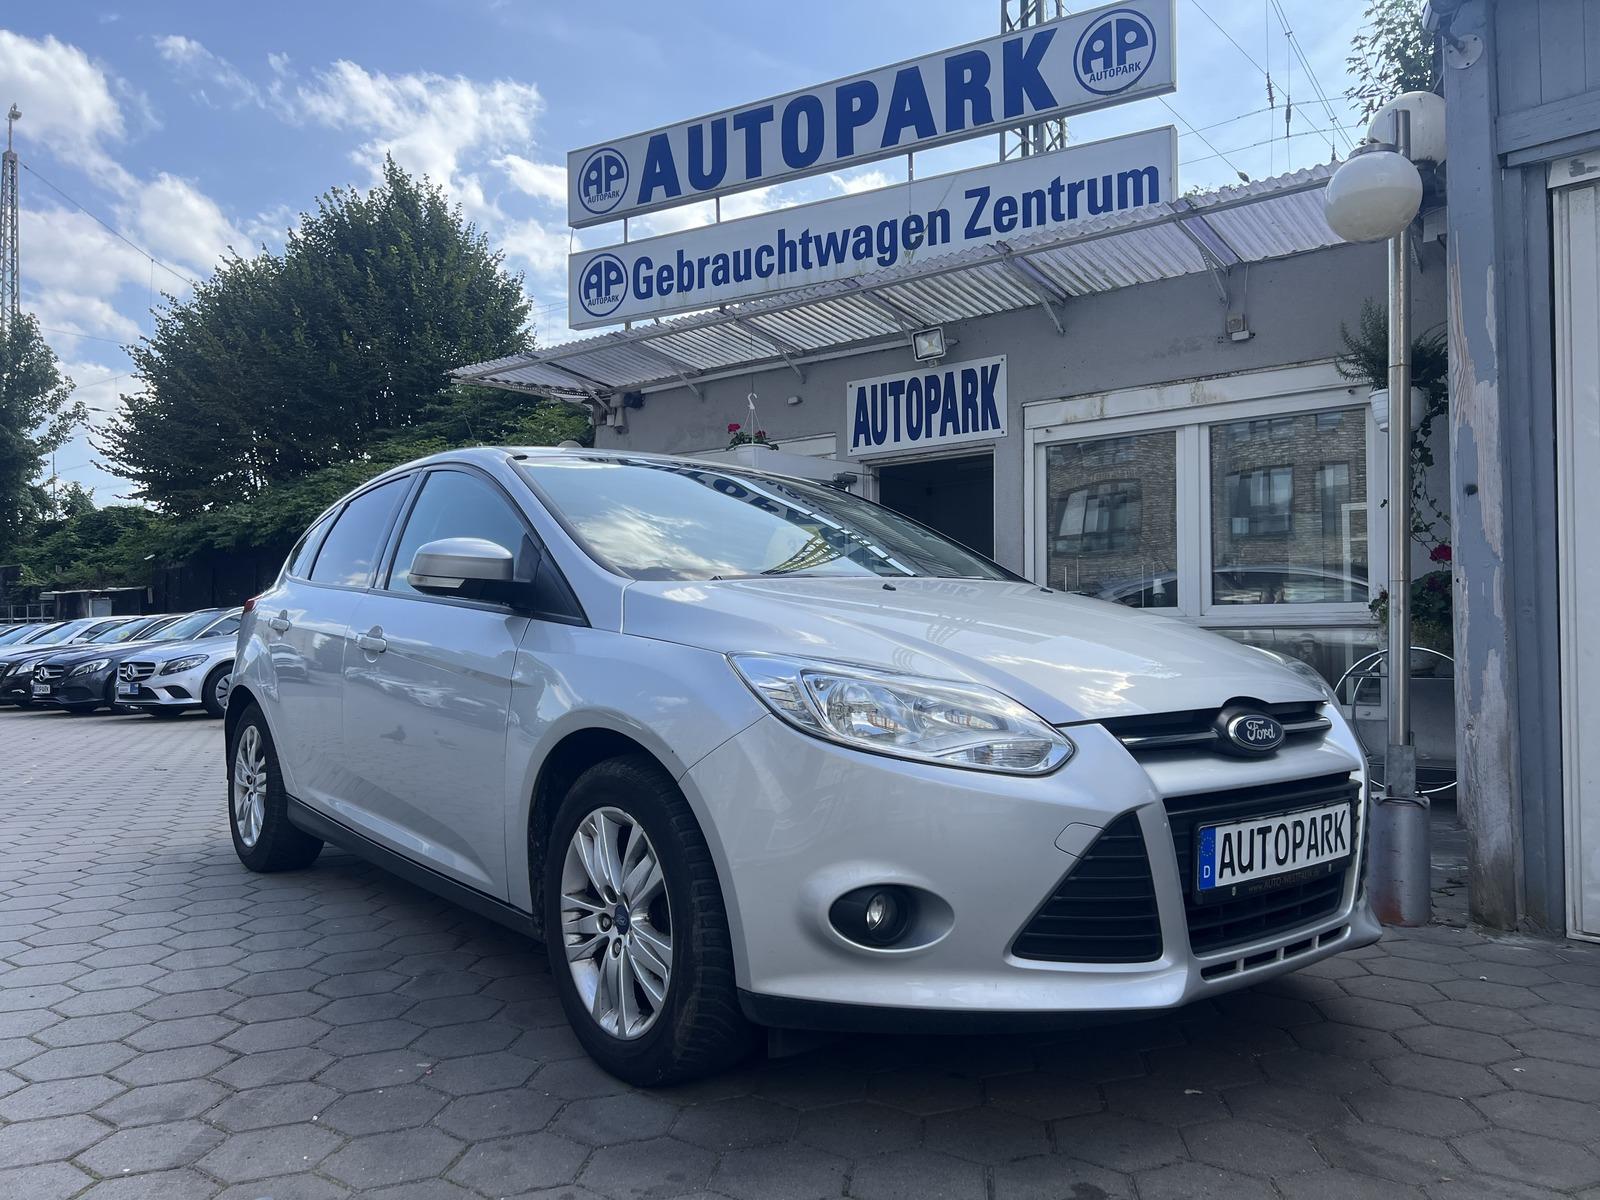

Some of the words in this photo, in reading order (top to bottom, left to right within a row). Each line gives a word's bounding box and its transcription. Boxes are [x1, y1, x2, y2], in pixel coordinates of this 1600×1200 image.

[1082, 19, 1148, 75] AP
[1089, 61, 1141, 83] AUTOPARK
[636, 28, 1059, 205] AUTOPARK
[583, 155, 625, 198] AP
[587, 190, 620, 204] AUTOPARK
[631, 208, 950, 300] Gebrauchtwagen
[964, 165, 1159, 240] Zentrum
[583, 260, 625, 300] AP
[587, 294, 620, 307] AUTOPARK
[852, 363, 1001, 448] AUTOPARK
[1245, 720, 1276, 741] Ford
[1203, 865, 1211, 879] D
[1218, 809, 1347, 879] AUTOPARK
